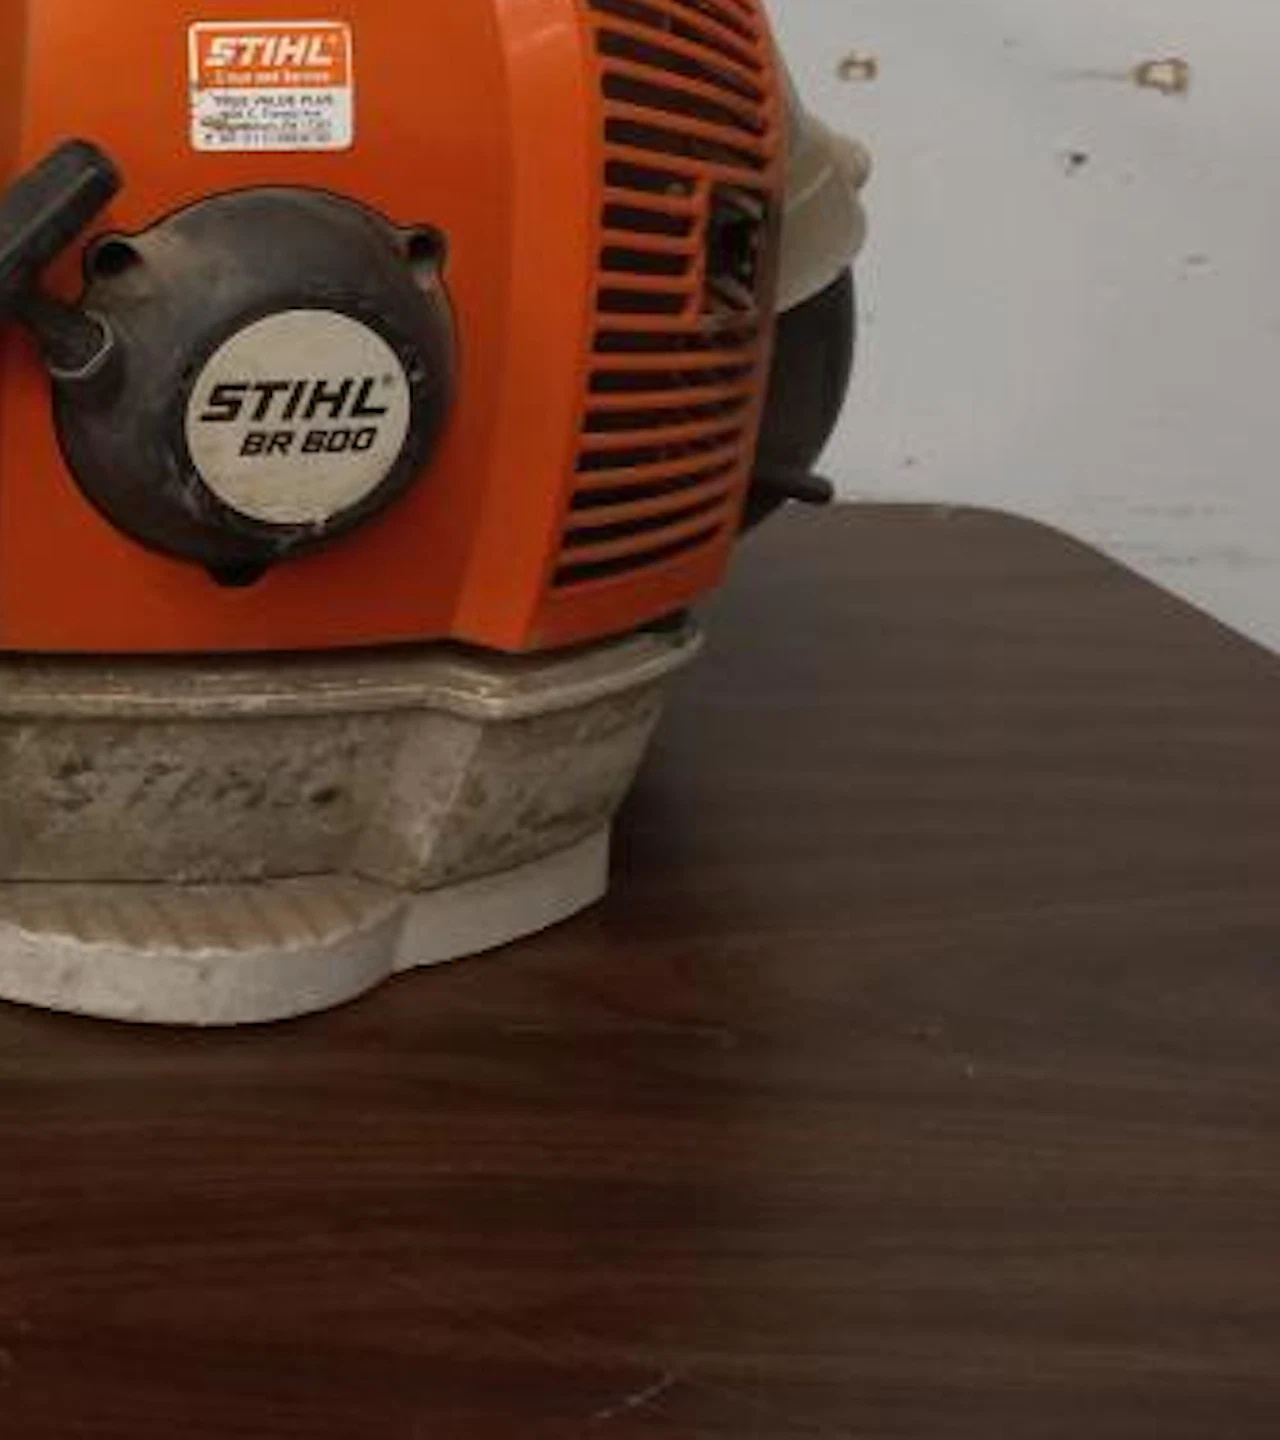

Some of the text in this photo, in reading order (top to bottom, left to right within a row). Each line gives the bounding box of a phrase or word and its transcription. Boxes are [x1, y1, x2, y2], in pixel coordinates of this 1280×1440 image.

[204, 35, 333, 67] STIHL
[200, 377, 389, 421] STIHL
[239, 427, 377, 457] BR 600
